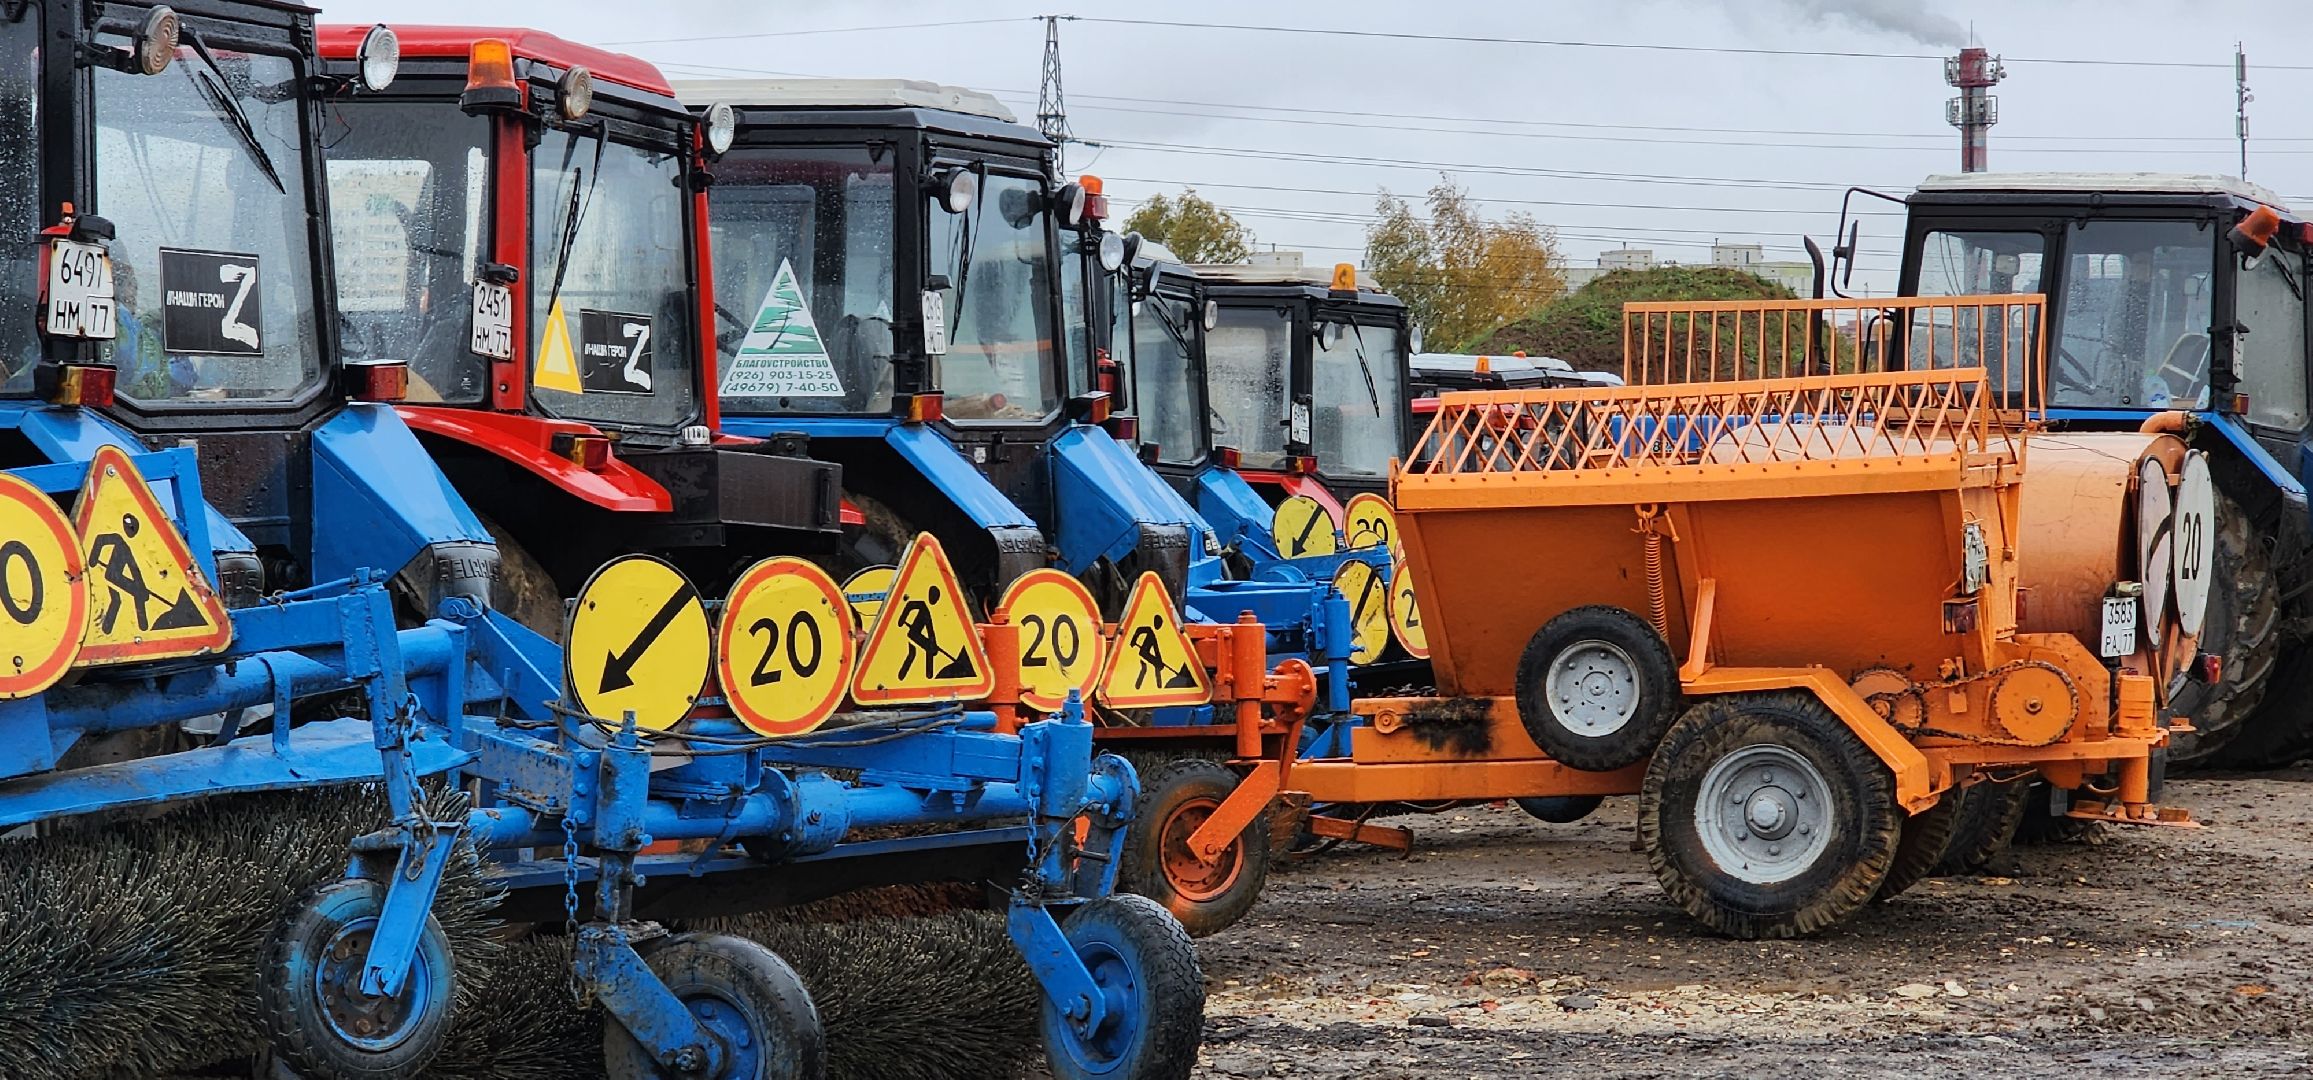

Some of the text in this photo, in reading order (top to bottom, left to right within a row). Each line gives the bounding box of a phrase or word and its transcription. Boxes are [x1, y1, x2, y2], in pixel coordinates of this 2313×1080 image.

[61, 248, 103, 288] 6497
[91, 303, 109, 333] 77
[219, 263, 259, 350] Z
[478, 286, 507, 320] 2451
[496, 330, 508, 353] 77
[622, 322, 652, 391] Z
[722, 382, 838, 394] (49679) 7-40-50
[729, 370, 833, 382] (926) 903-15-25
[2182, 512, 2201, 580] 20
[2108, 601, 2133, 625] 3583
[748, 610, 822, 687] 20
[1020, 613, 1080, 668] 20
[2123, 632, 2133, 652] 77
